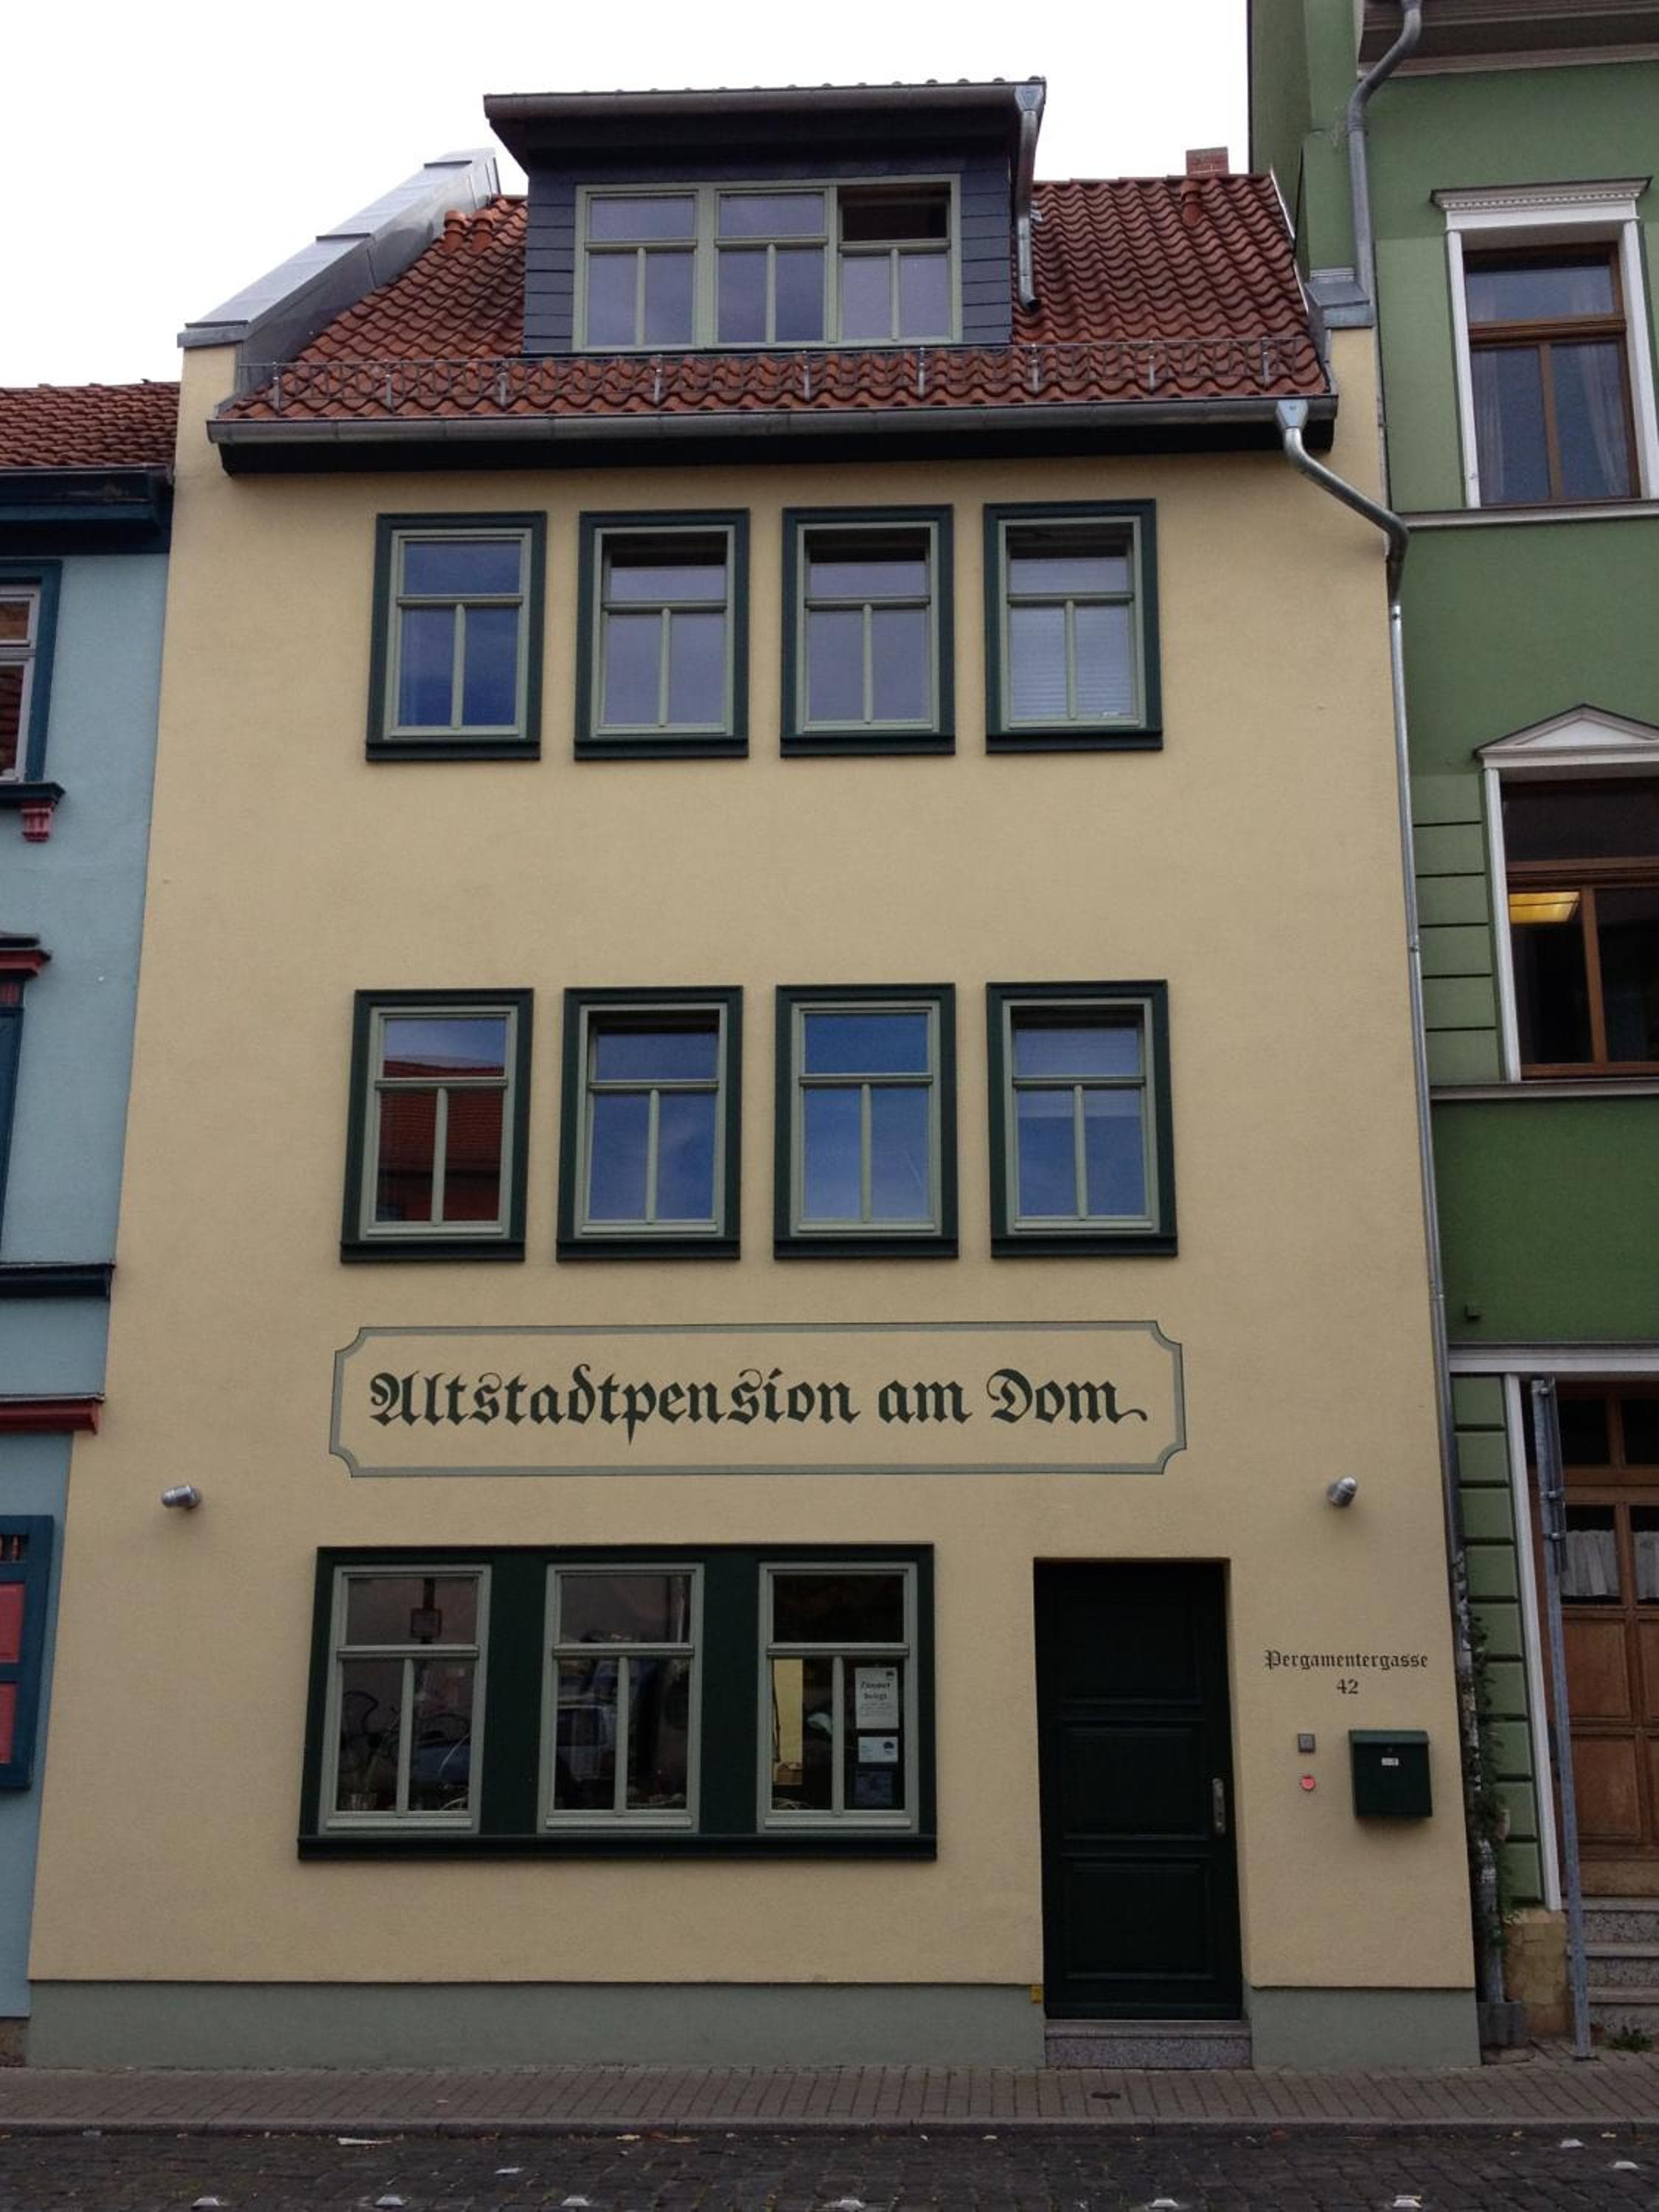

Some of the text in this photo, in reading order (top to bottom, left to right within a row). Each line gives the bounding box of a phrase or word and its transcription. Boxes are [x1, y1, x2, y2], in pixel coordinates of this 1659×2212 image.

[370, 1363, 1148, 1444] Altstadtpension am Dom
[1265, 1649, 1428, 1671] Pergamentergasse
[1336, 1678, 1359, 1695] 42
